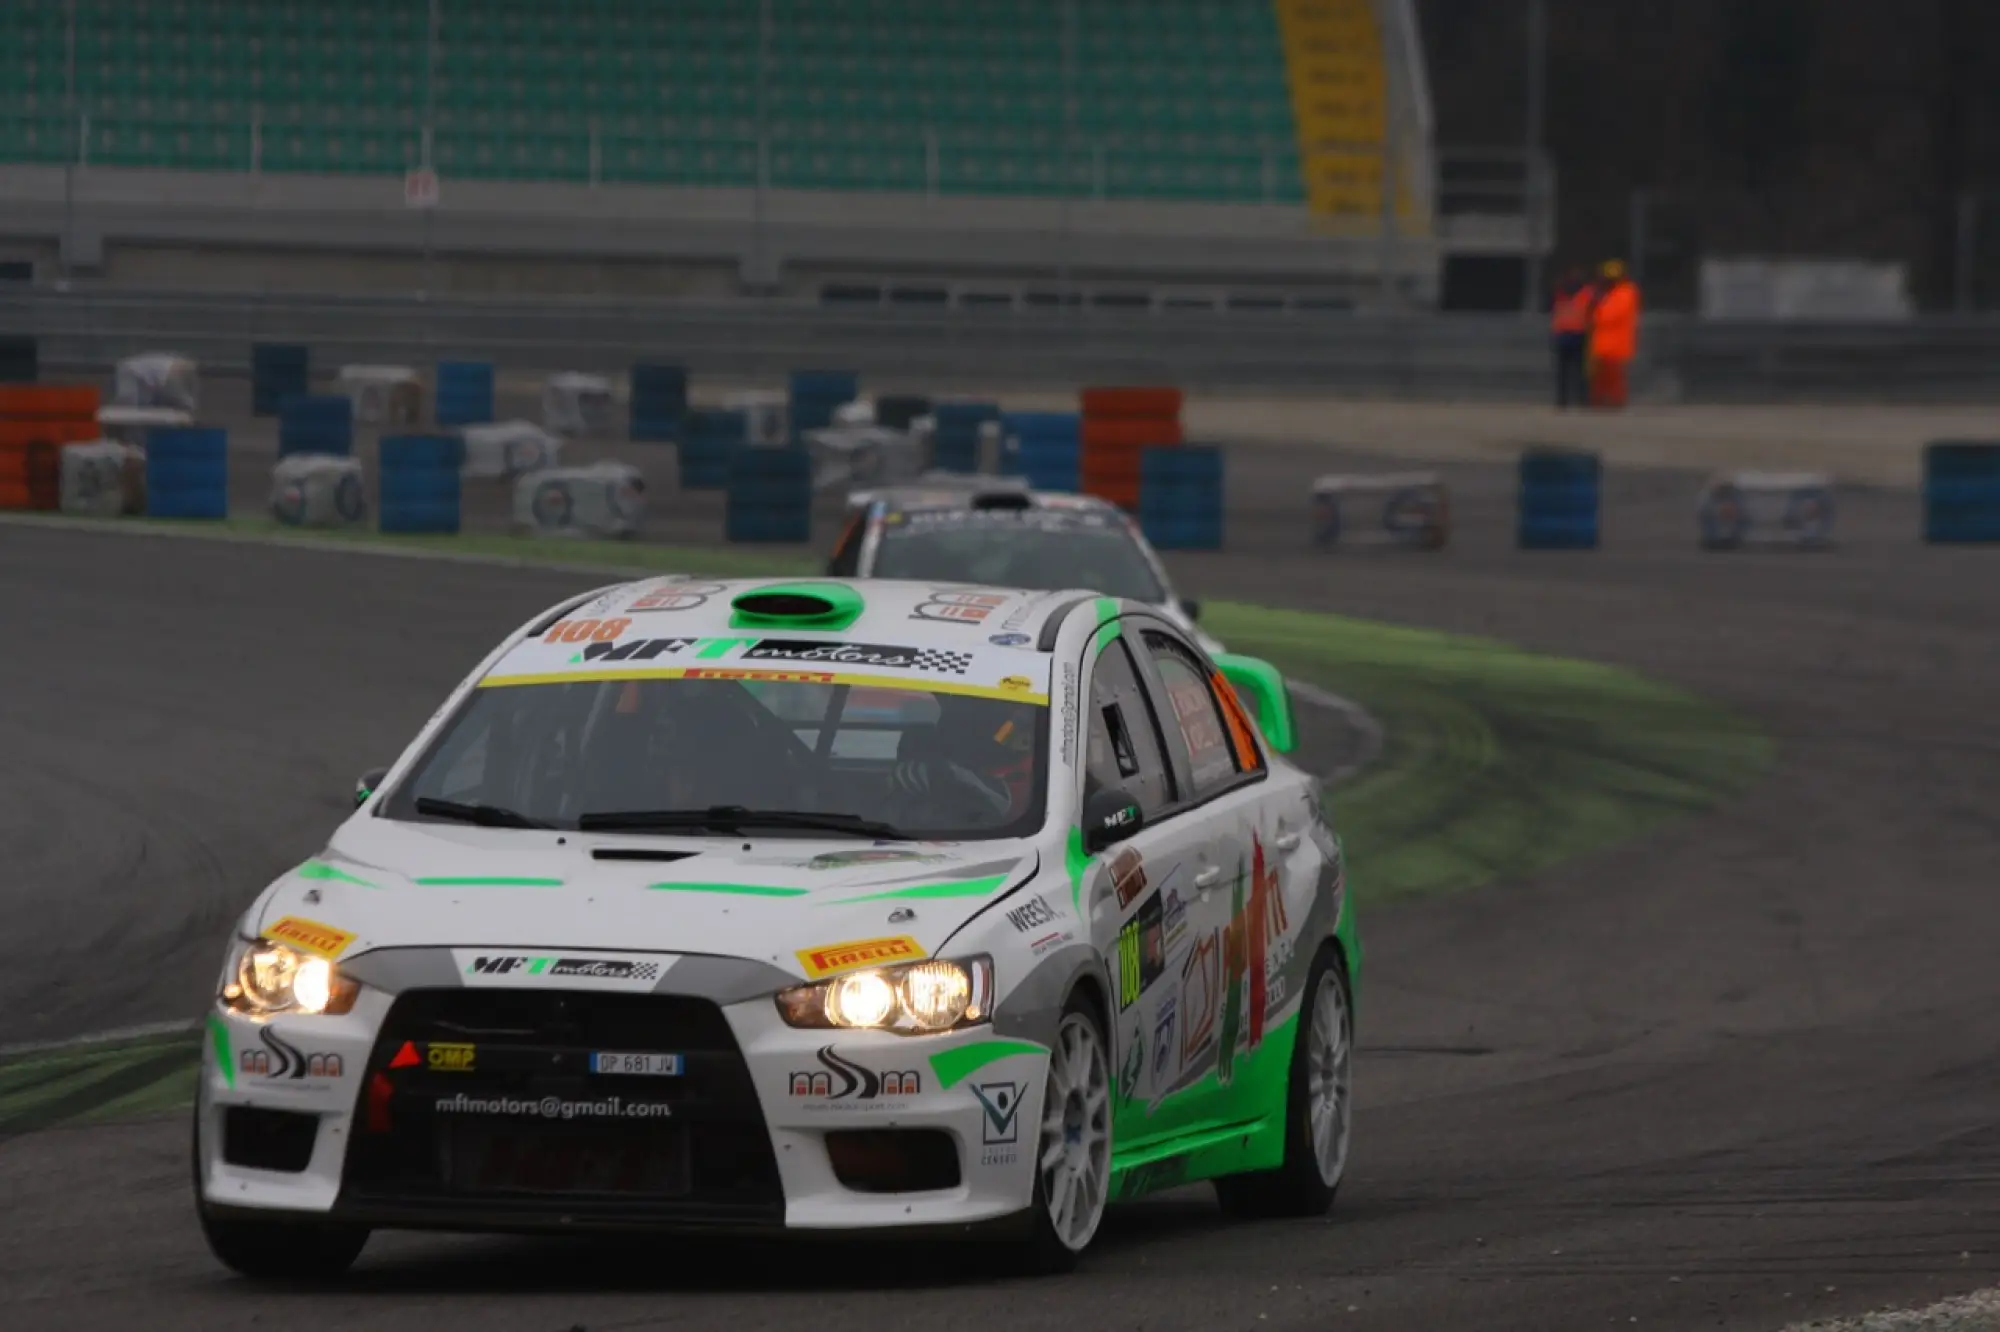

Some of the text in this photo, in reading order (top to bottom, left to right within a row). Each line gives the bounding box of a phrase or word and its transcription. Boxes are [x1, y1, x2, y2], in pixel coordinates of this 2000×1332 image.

[543, 617, 633, 644] 108
[567, 637, 912, 666] MFT motors
[272, 919, 345, 951] PIRELLI
[465, 956, 630, 978] MFT motors
[810, 939, 915, 972] PIRELLI
[427, 1043, 476, 1070] OMP
[624, 1055, 651, 1073] 681
[435, 1093, 672, 1118] mftmotors@gmail.com
